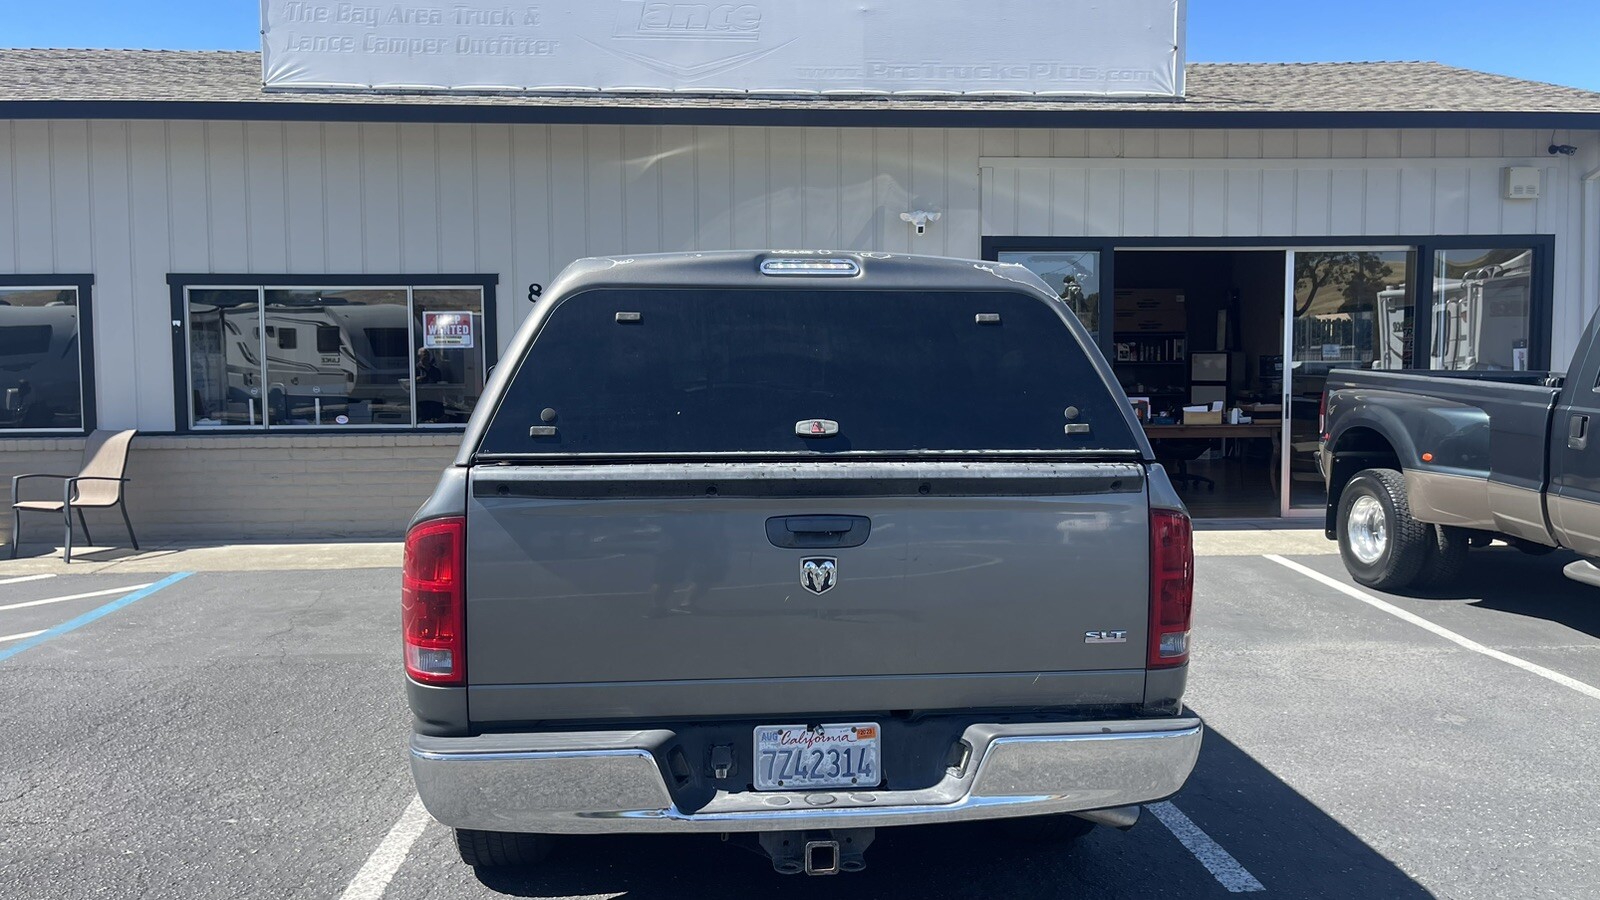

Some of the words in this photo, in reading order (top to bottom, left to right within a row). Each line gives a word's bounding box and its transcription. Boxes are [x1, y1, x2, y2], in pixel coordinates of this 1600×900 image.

[286, 1, 329, 22] The
[336, 2, 380, 28] Bay
[387, 3, 442, 25] Area
[453, 5, 516, 26] Truck
[523, 6, 540, 26] &
[286, 30, 354, 52] Lance
[362, 32, 448, 57] Camper
[456, 34, 559, 56] Outfitter
[528, 283, 542, 303] 8
[428, 325, 469, 335] WANTED
[1085, 630, 1127, 642] SLT
[761, 732, 778, 741] AUG
[781, 730, 858, 749] California
[762, 748, 872, 780] 7Z42314
